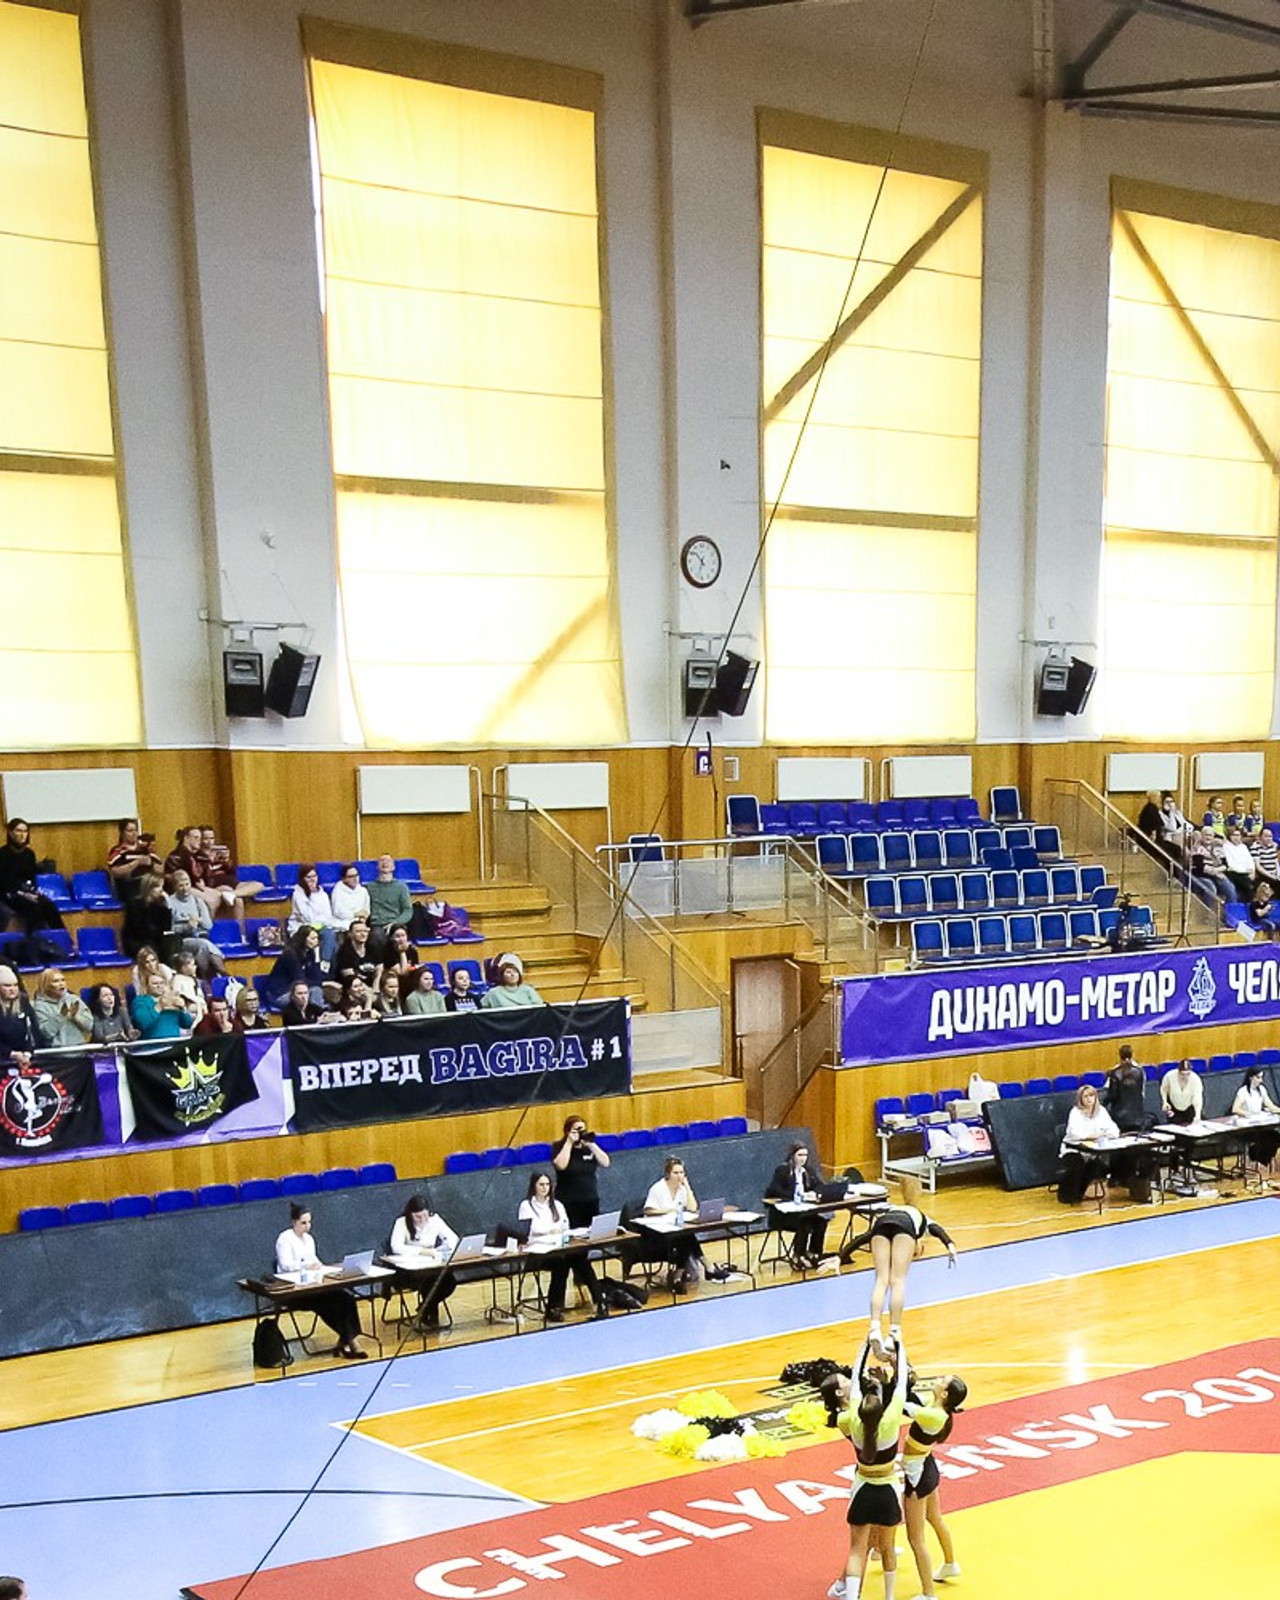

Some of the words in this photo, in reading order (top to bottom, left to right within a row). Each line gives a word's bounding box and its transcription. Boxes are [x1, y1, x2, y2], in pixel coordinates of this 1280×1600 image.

[928, 970, 1176, 1042] ДИНАМО-МЕТАР
[299, 1053, 423, 1091] ВПЕРЕД
[429, 1035, 588, 1084] BAGIRA
